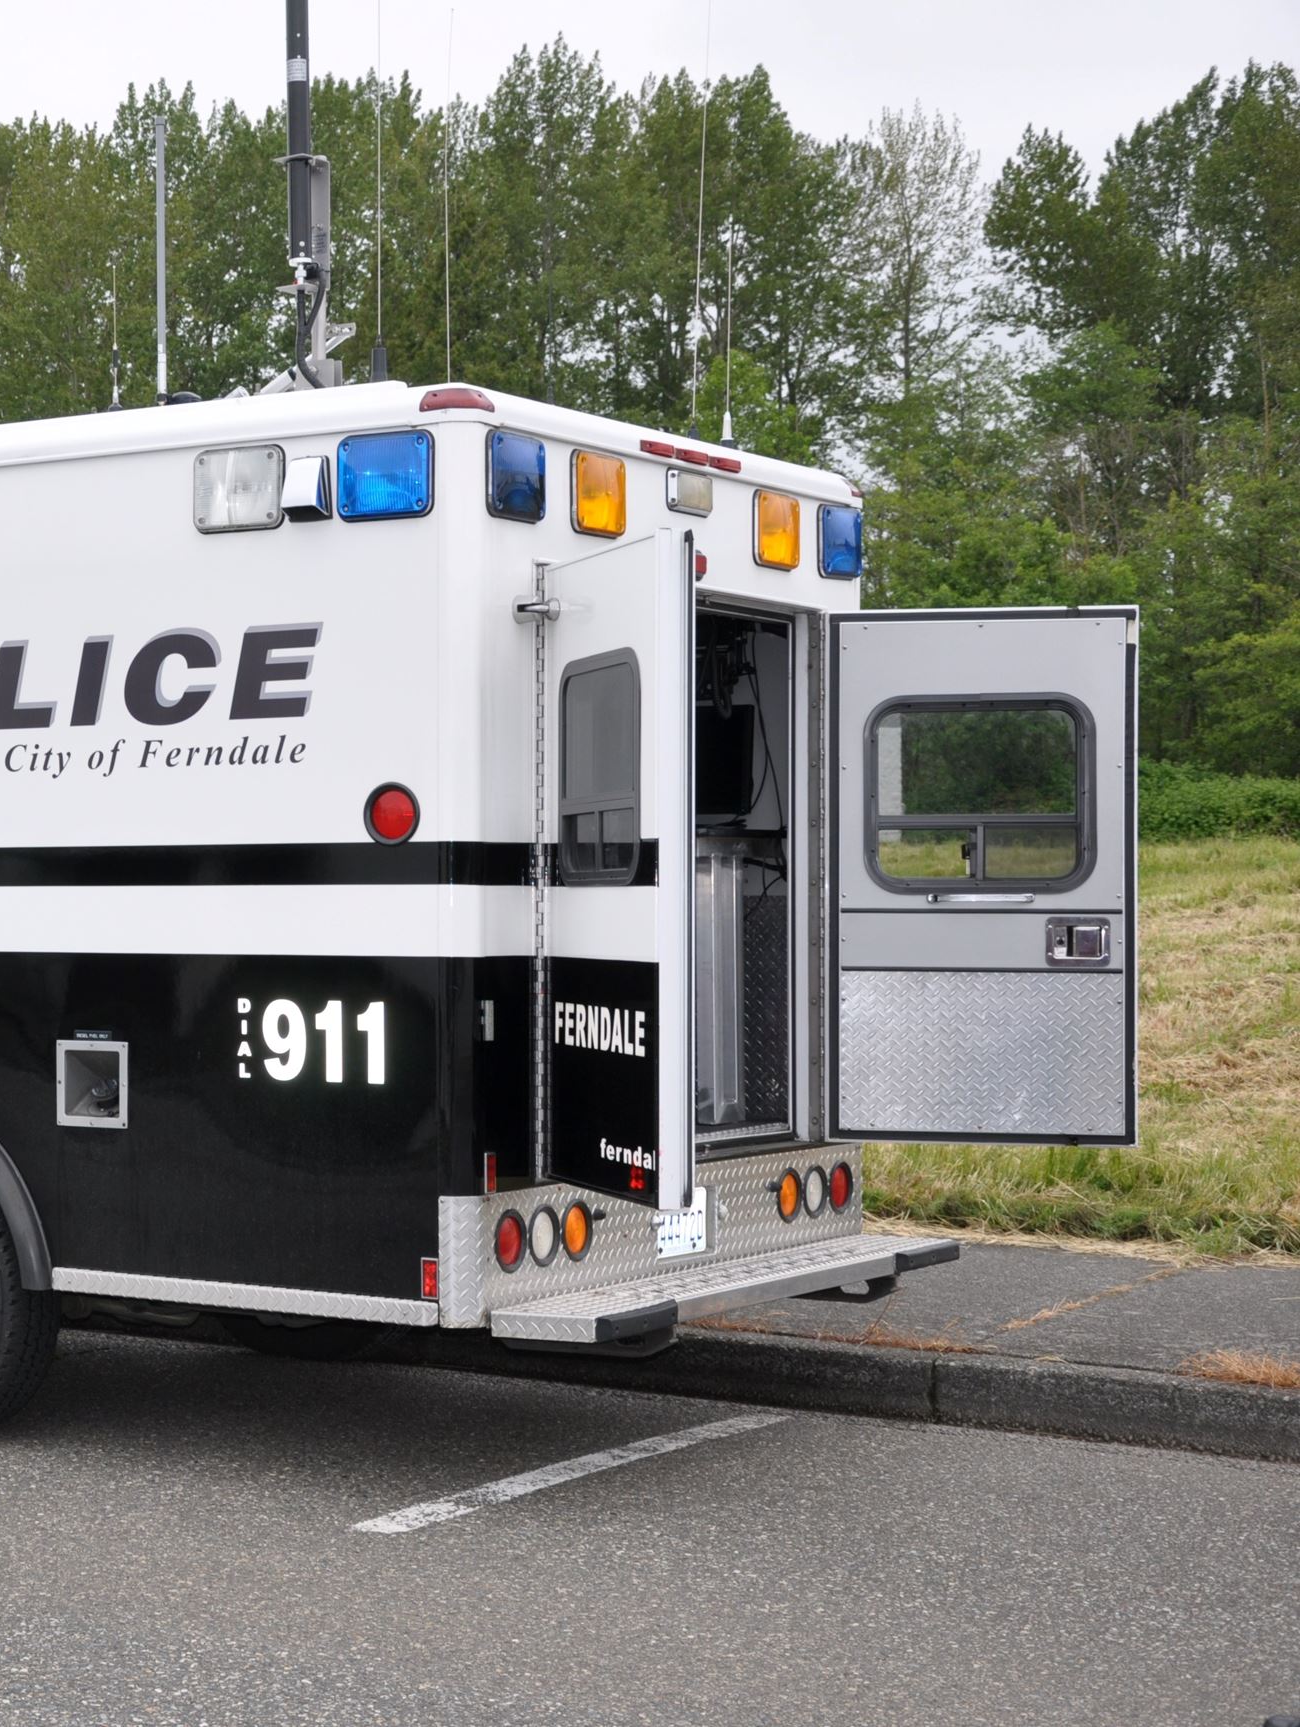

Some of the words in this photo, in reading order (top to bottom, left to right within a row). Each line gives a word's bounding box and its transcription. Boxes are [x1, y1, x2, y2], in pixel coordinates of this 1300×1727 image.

[4, 743, 72, 779] City
[87, 738, 126, 777] of
[138, 734, 307, 769] Ferndale
[237, 997, 252, 1079] DIAL
[262, 998, 385, 1085] 911
[554, 1001, 646, 1058] FERNDALE
